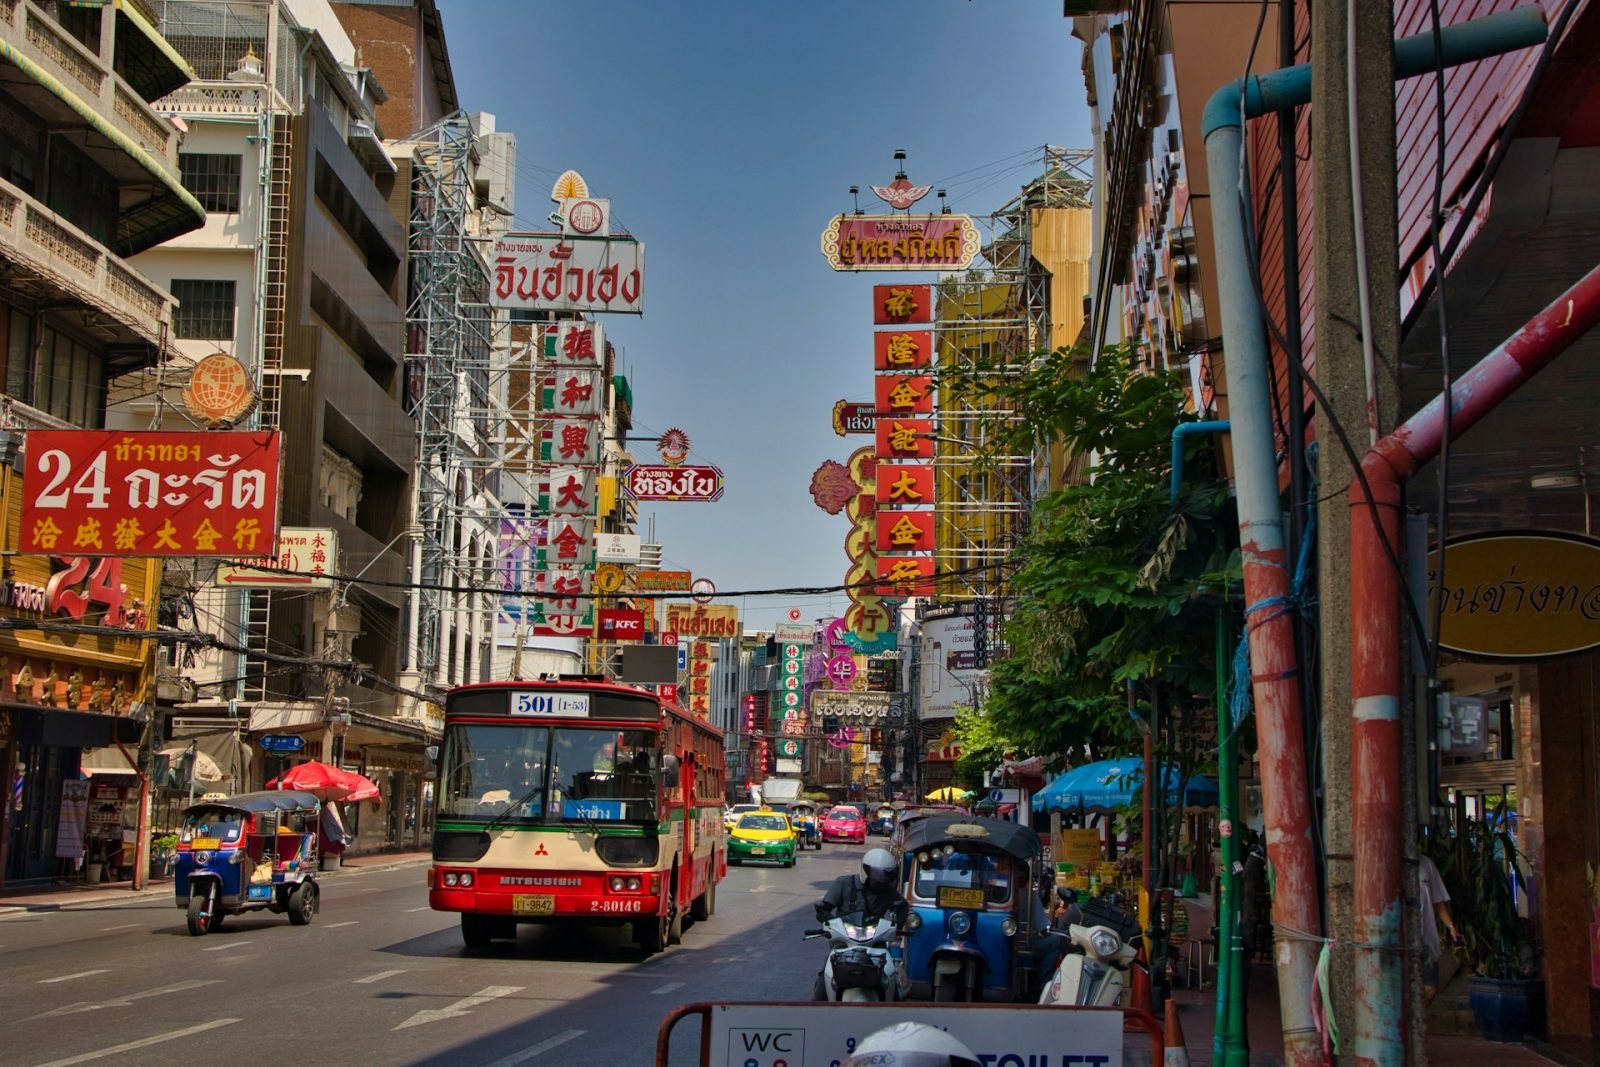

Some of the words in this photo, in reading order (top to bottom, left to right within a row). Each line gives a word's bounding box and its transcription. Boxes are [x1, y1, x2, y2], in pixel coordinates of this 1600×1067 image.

[113, 436, 201, 462] ห้างทอง
[34, 449, 111, 509] 24
[124, 453, 267, 510] กะรัต
[633, 469, 714, 496] ทองใบ
[615, 619, 640, 629] KFC
[518, 694, 554, 713] 501
[499, 875, 582, 886] MITSUBISHI
[590, 899, 641, 912] 2-80146
[741, 1032, 793, 1052] WC
